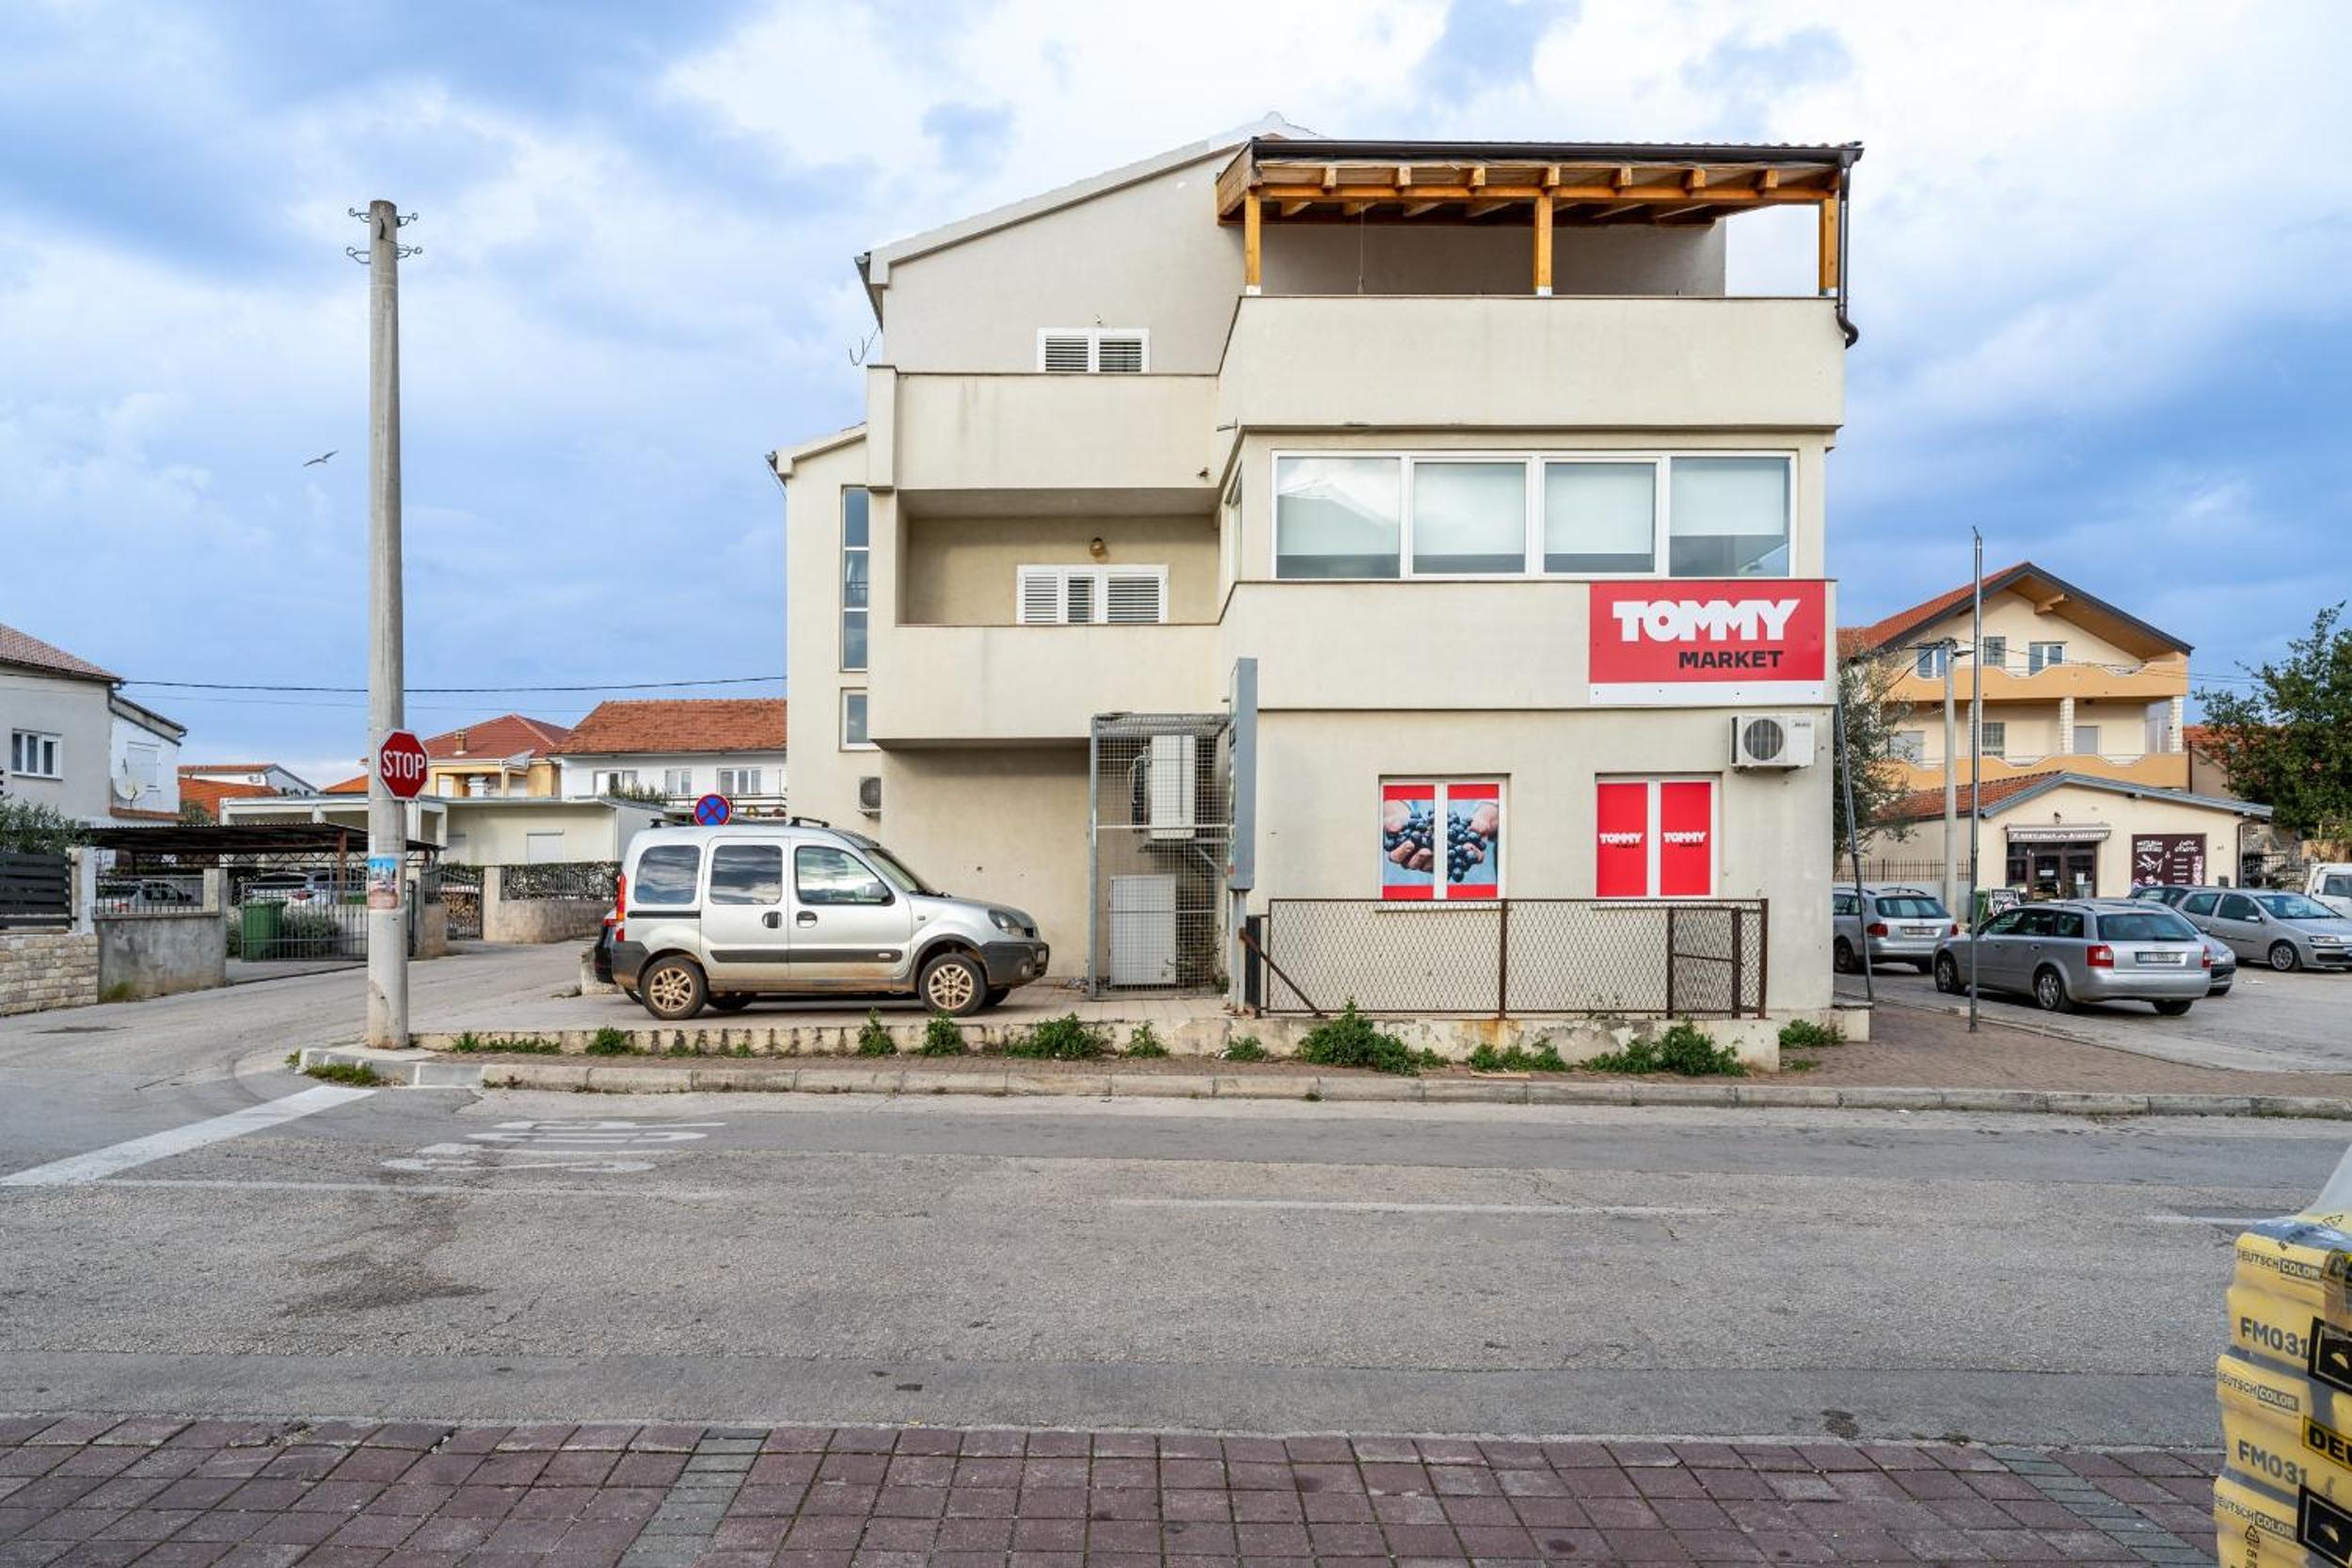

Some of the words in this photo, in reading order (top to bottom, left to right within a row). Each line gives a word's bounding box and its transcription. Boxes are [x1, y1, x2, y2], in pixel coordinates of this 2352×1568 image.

[1612, 598, 1801, 642] TOMMY
[1678, 650, 1784, 669] MARKET
[382, 751, 425, 781] STOP
[2241, 1317, 2309, 1359] FM031
[2239, 1439, 2307, 1485] FM031
